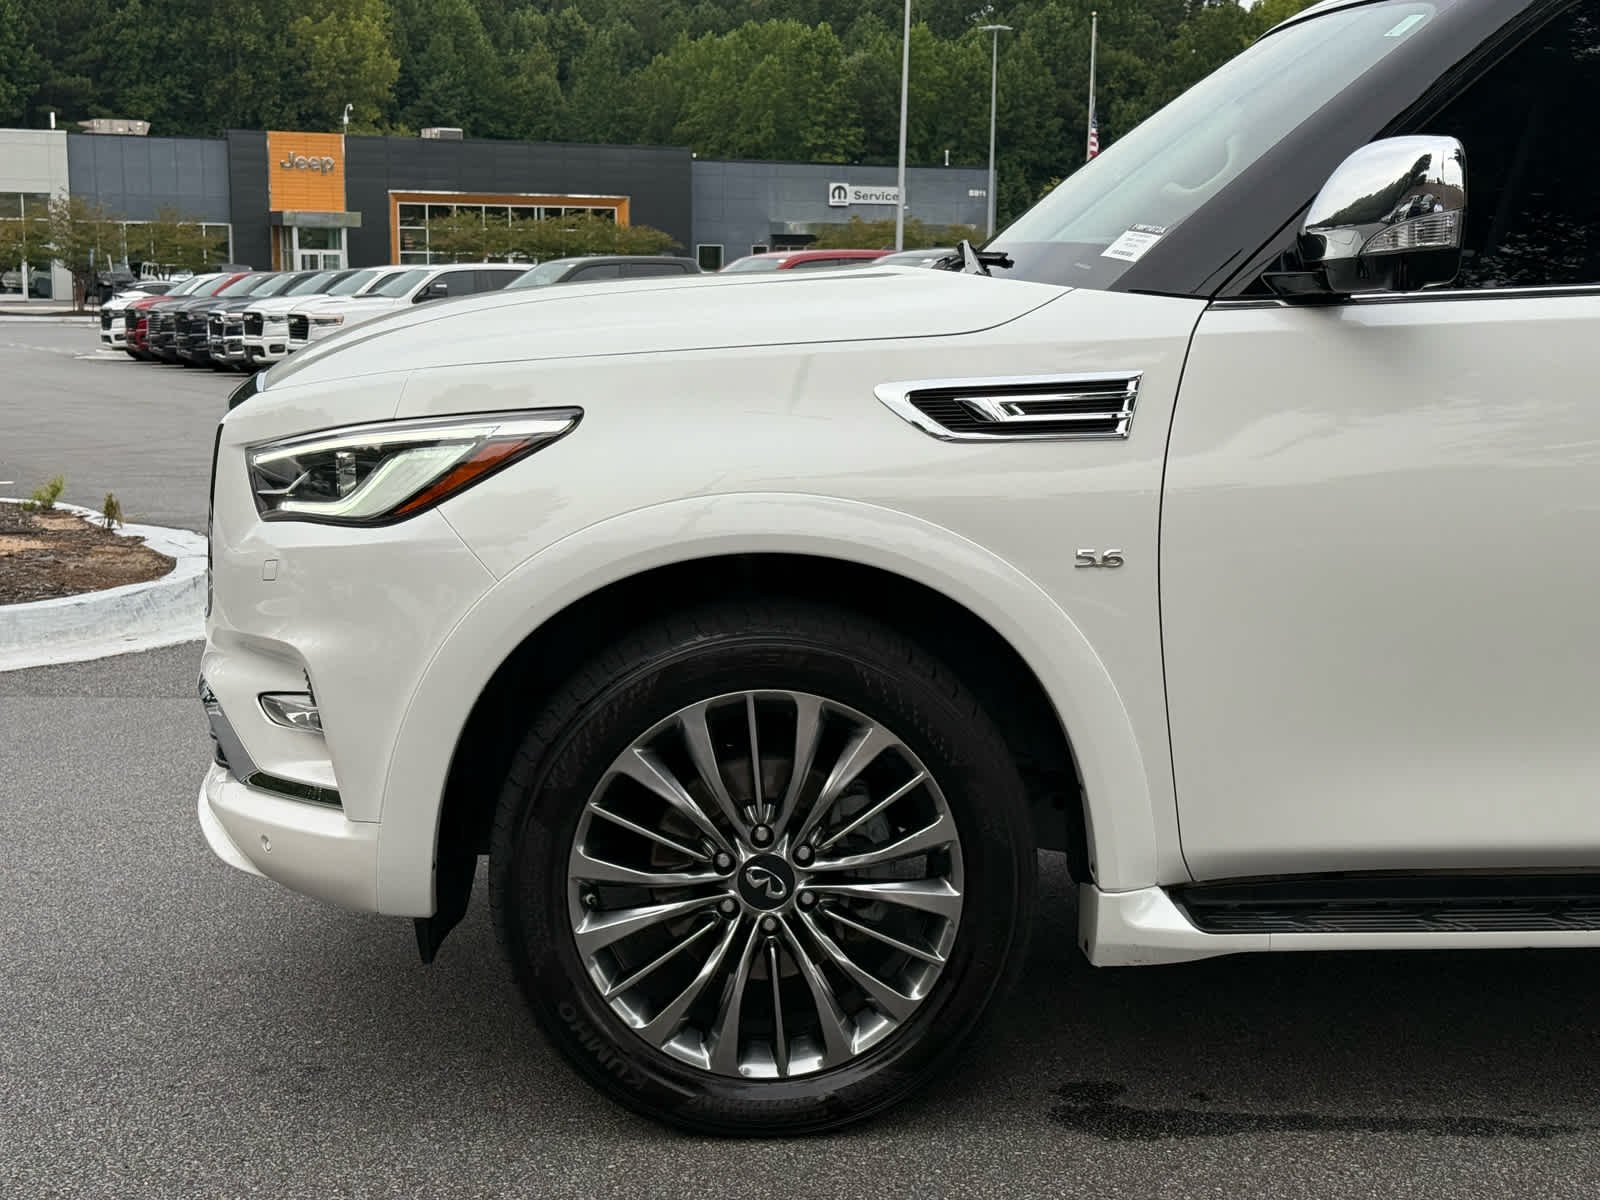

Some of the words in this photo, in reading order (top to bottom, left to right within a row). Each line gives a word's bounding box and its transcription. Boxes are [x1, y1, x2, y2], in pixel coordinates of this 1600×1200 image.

[280, 151, 335, 176] Jeep
[854, 190, 900, 201] Service
[1075, 548, 1124, 569] 5.6
[558, 1001, 647, 1088] KUMHO
